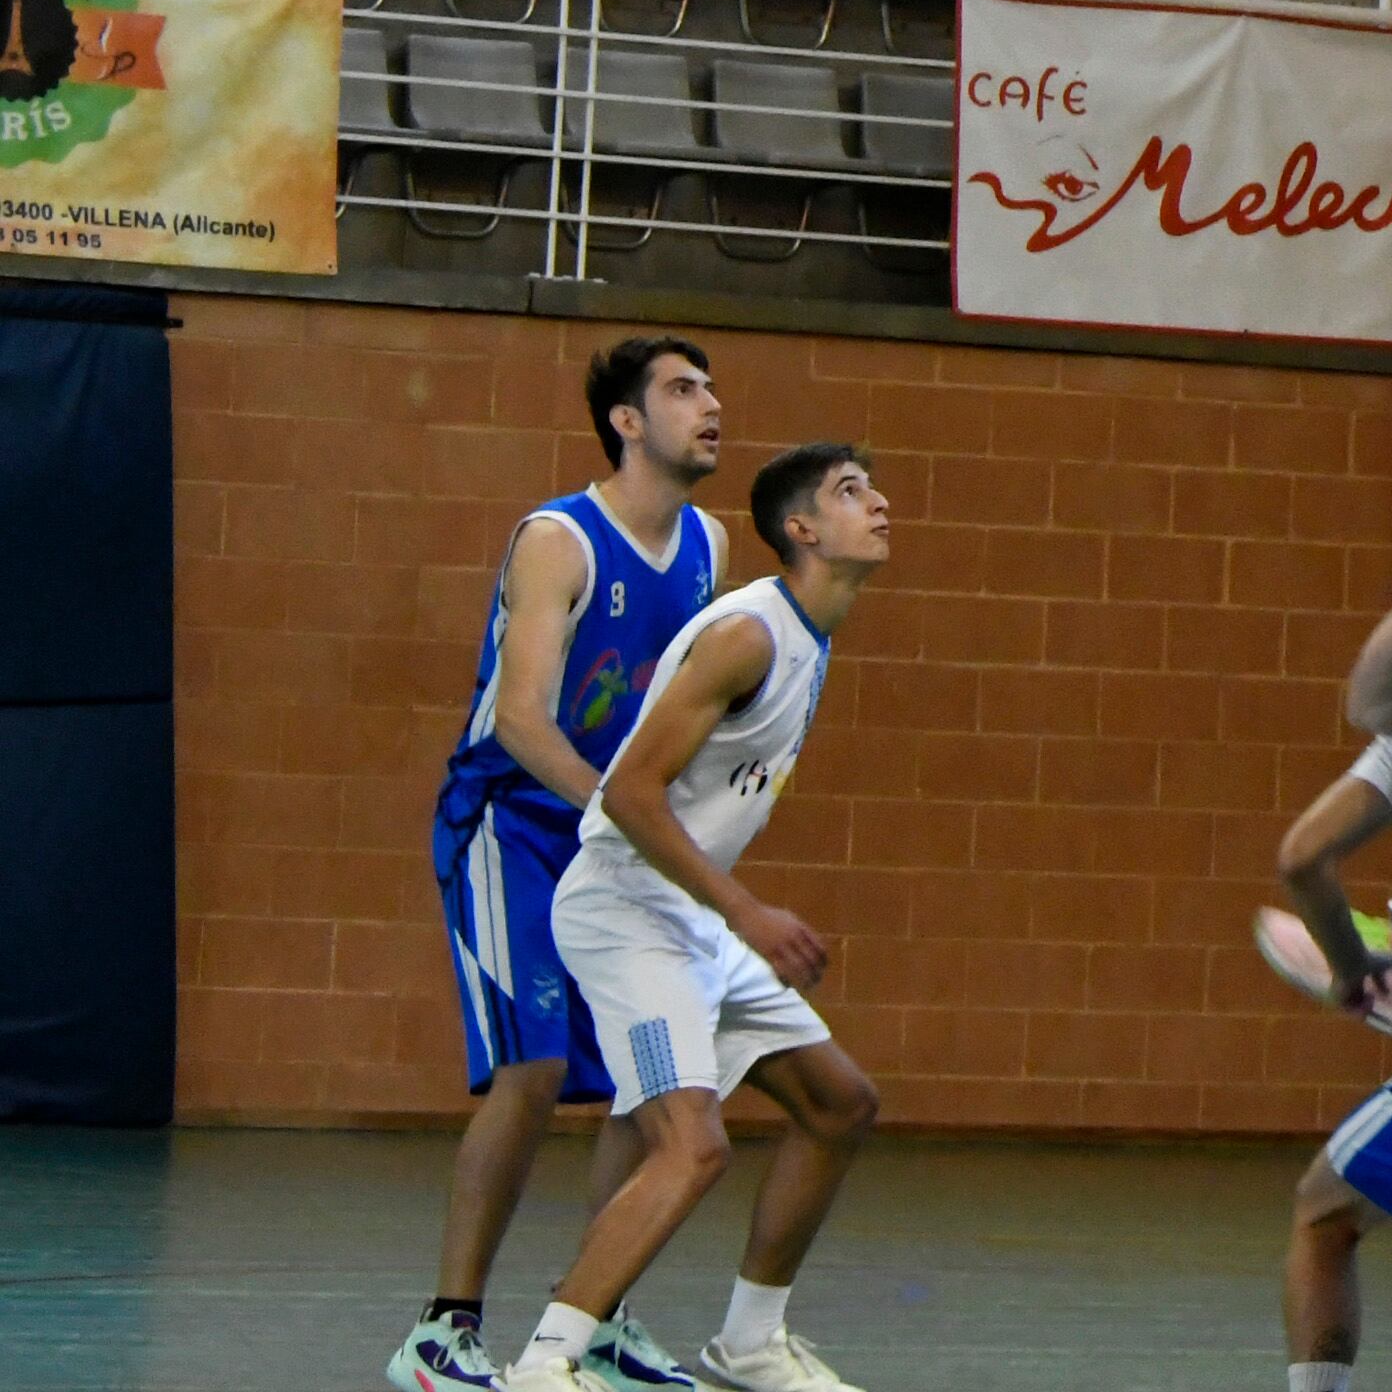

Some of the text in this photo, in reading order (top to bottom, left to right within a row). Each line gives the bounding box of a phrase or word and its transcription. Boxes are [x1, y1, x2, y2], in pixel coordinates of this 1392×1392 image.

[0, 199, 53, 221] 3400
[173, 213, 275, 243] (Alicante)
[46, 231, 68, 247] 11
